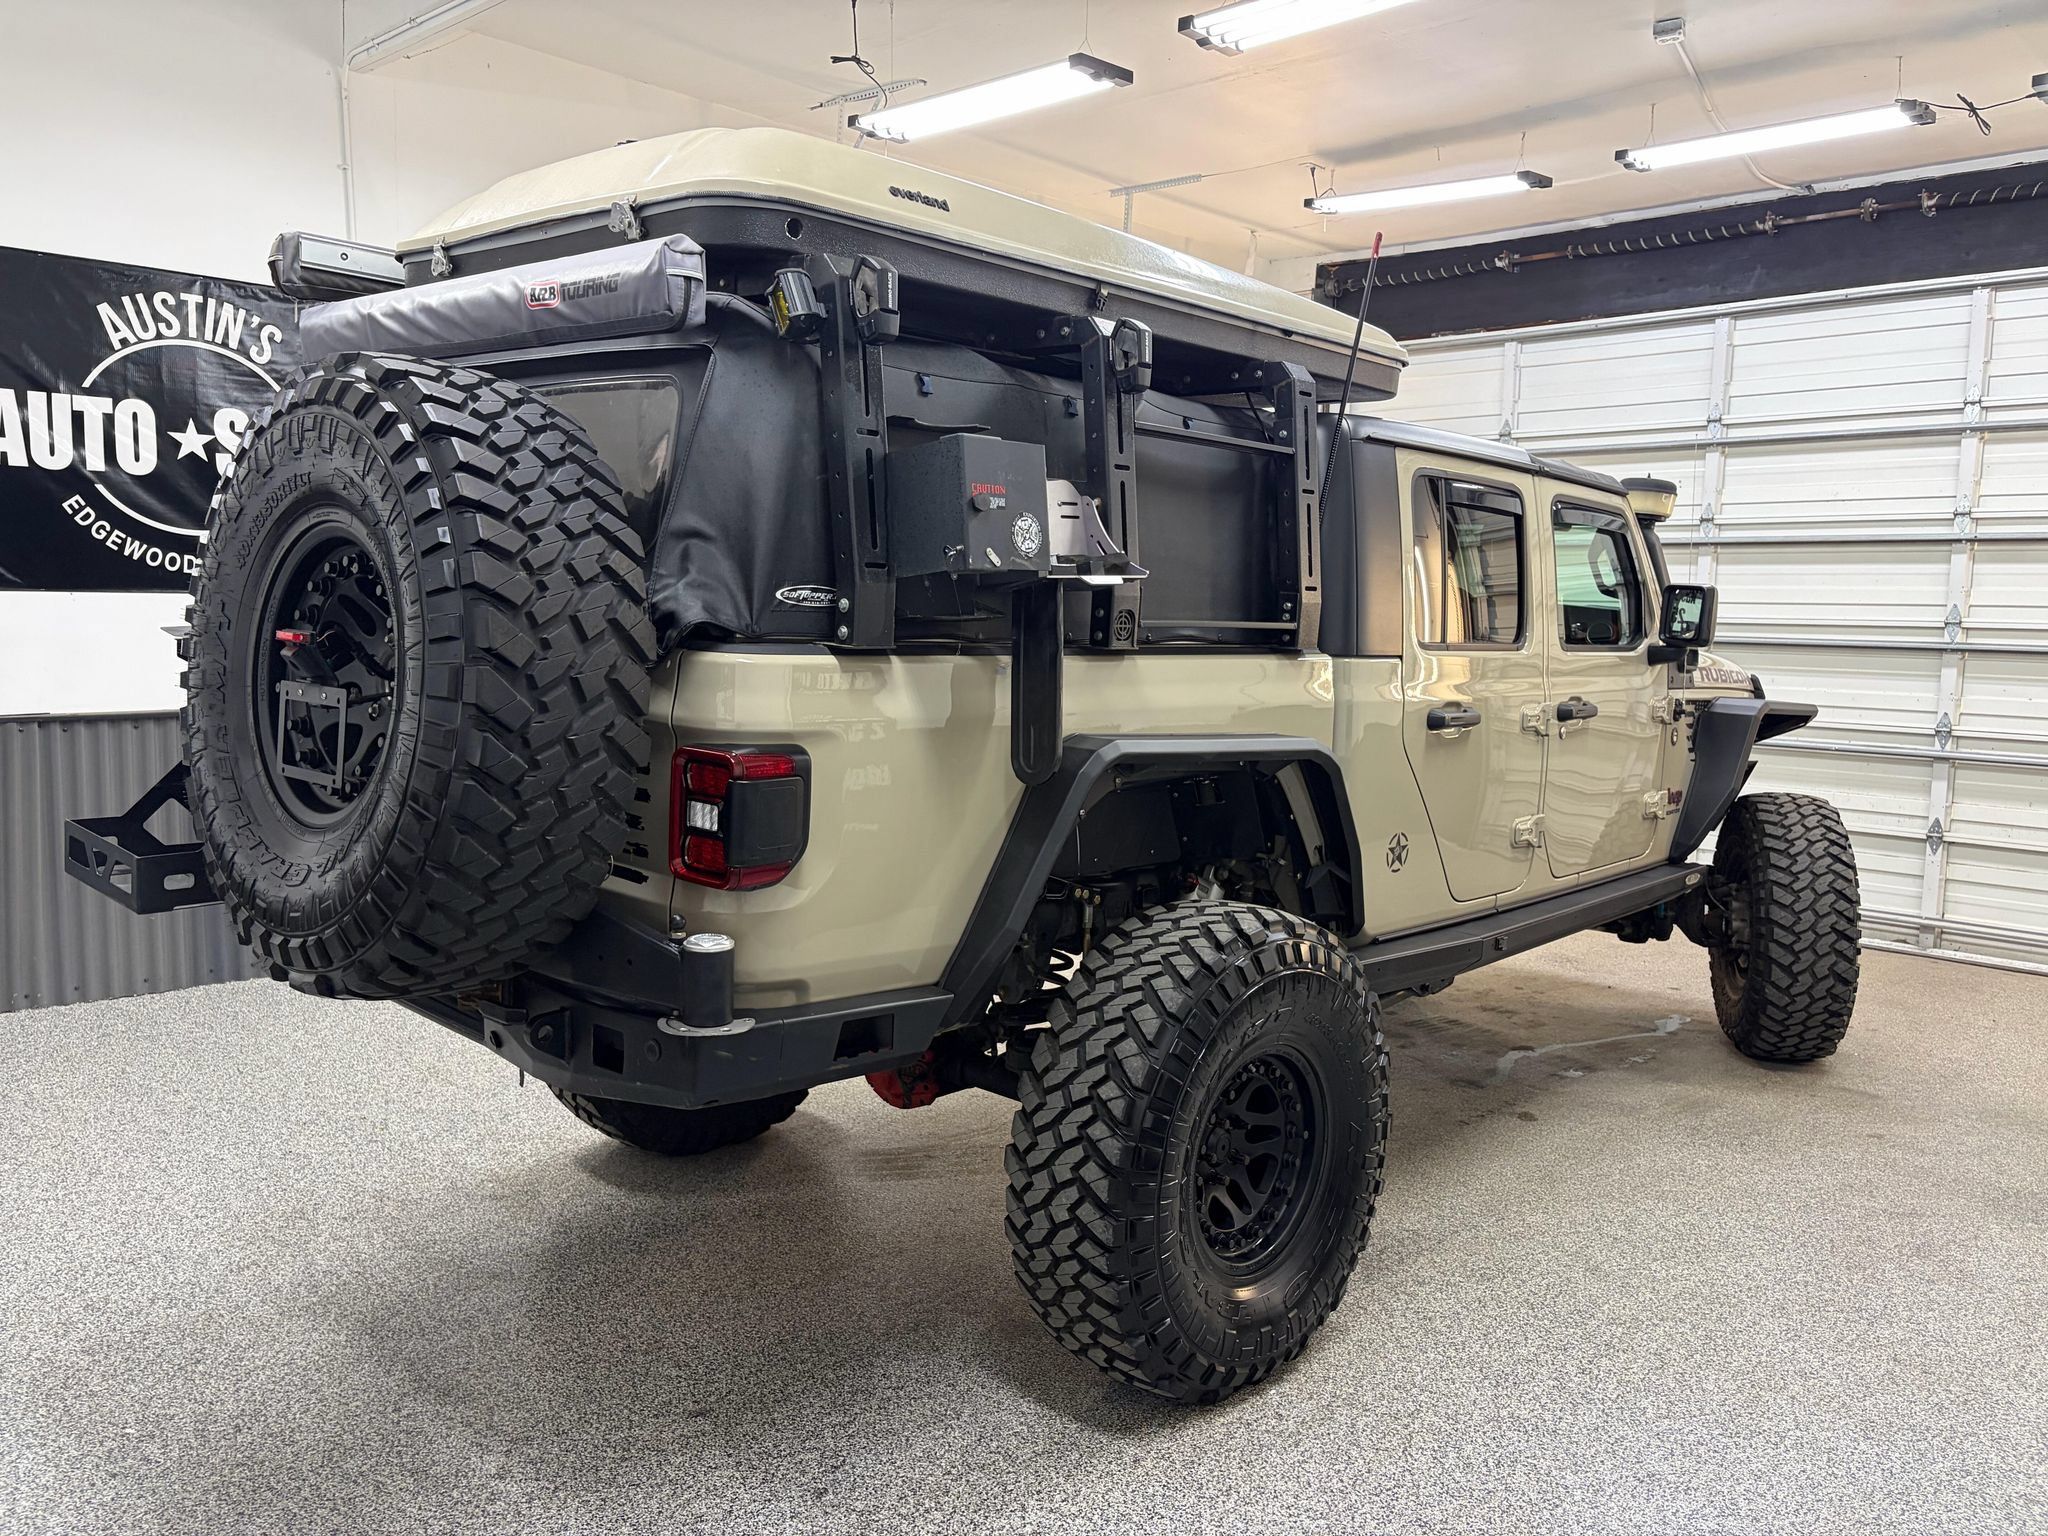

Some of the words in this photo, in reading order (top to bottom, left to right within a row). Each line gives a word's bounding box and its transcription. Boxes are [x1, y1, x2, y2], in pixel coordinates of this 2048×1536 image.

[560, 273, 621, 301] TOURING
[96, 291, 283, 365] AUSTIN'S
[0, 388, 158, 476] AUTO
[971, 483, 1007, 496] CAUTION
[61, 493, 198, 577] EDGEWOOD
[1698, 666, 1752, 685] RUBICON
